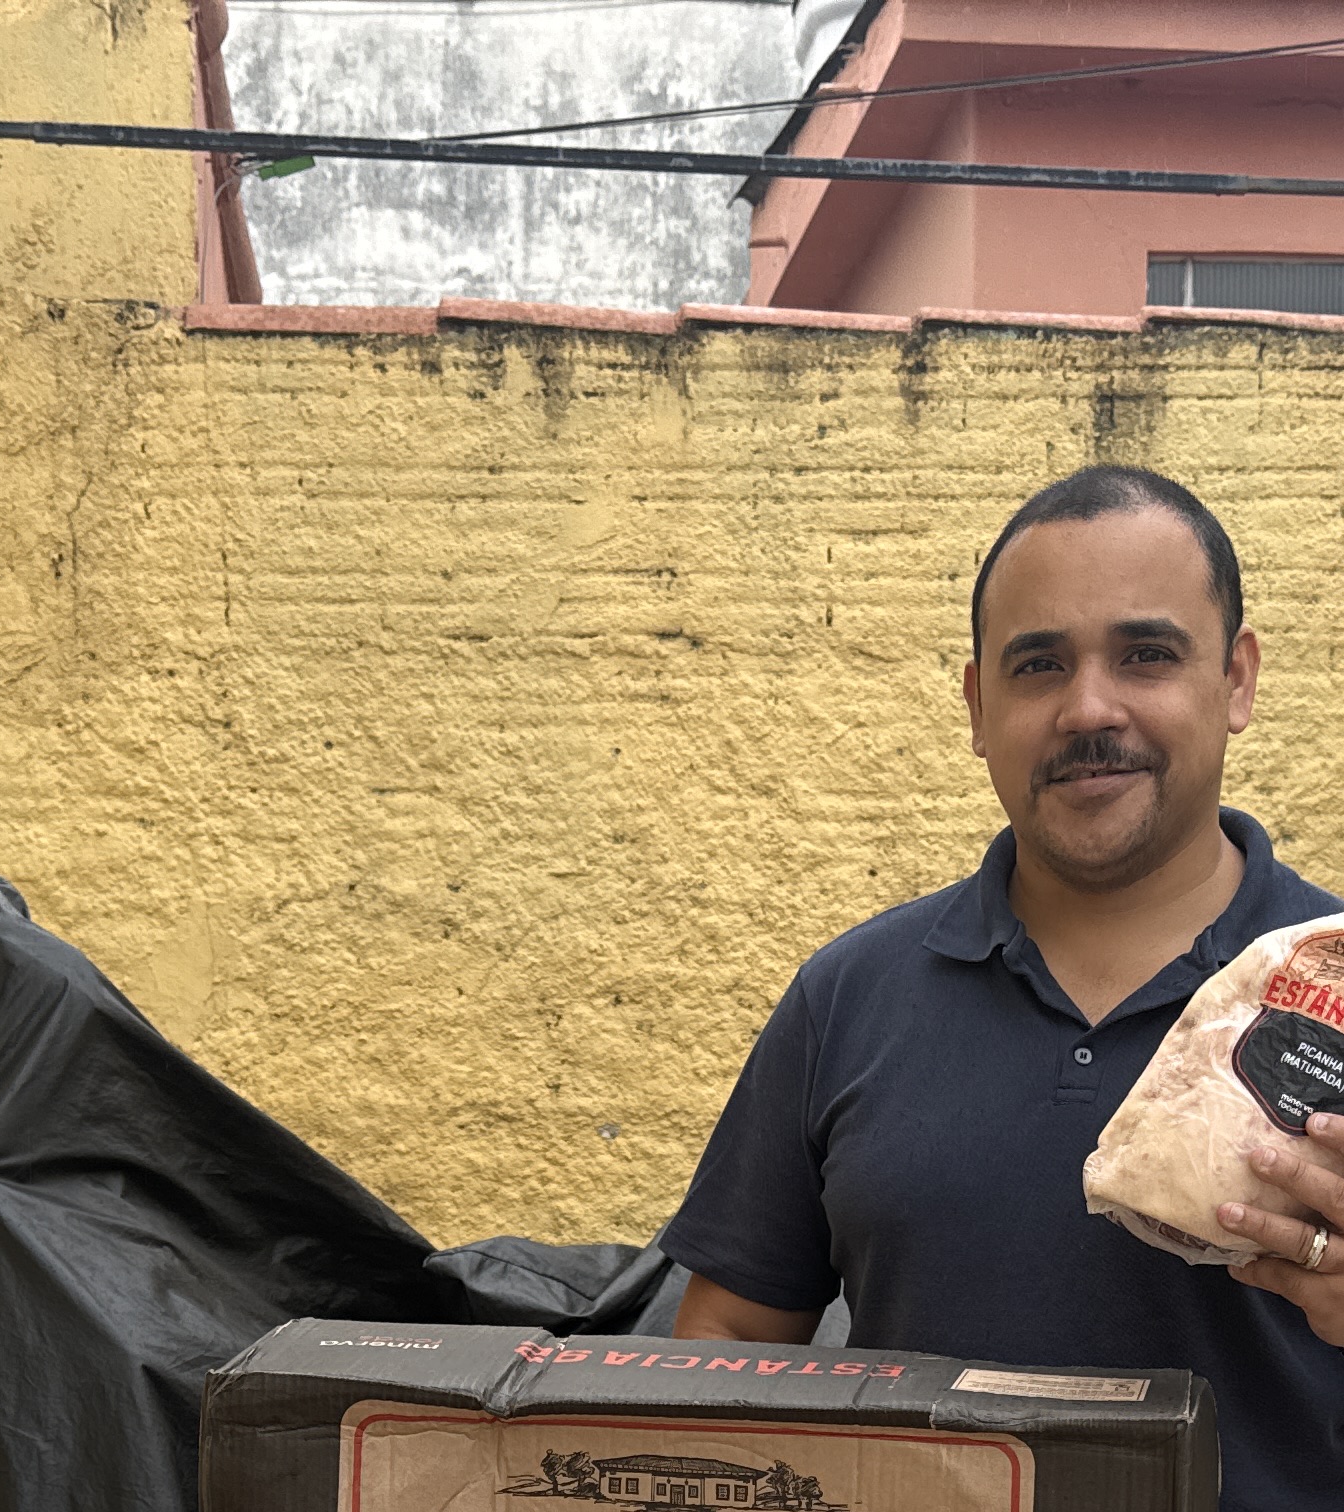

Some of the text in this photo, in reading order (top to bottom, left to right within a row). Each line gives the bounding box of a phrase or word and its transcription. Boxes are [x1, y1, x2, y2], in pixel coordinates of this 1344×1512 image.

[1297, 1042, 1344, 1073] PICANHA
[1278, 1100, 1302, 1116] foods
[1281, 1093, 1314, 1114] minerva
[319, 1340, 440, 1350] minerva
